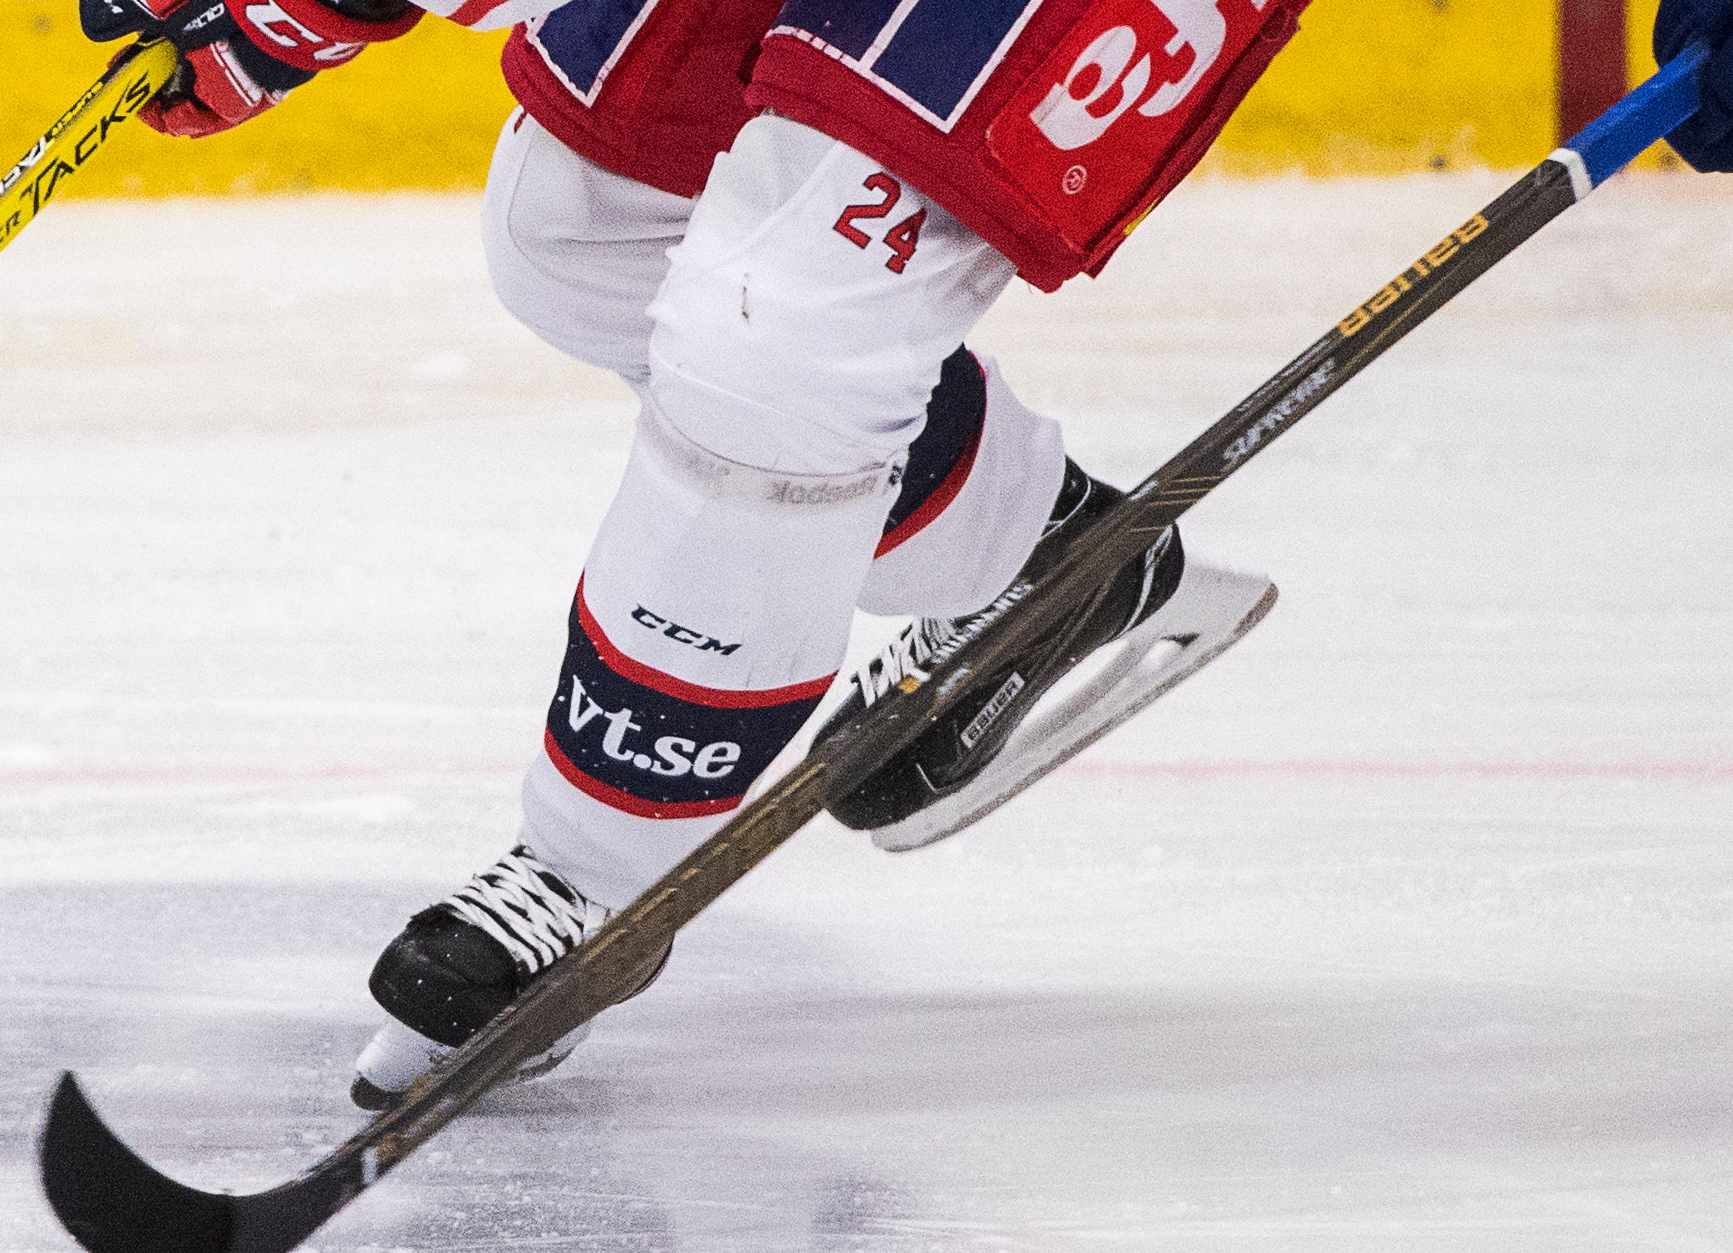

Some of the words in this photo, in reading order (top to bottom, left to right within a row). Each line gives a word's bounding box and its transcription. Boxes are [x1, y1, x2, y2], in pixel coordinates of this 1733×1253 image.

[19, 71, 151, 216] TACKS
[832, 173, 927, 275] 24
[631, 602, 742, 657] CCM
[565, 676, 742, 780] vt.se
